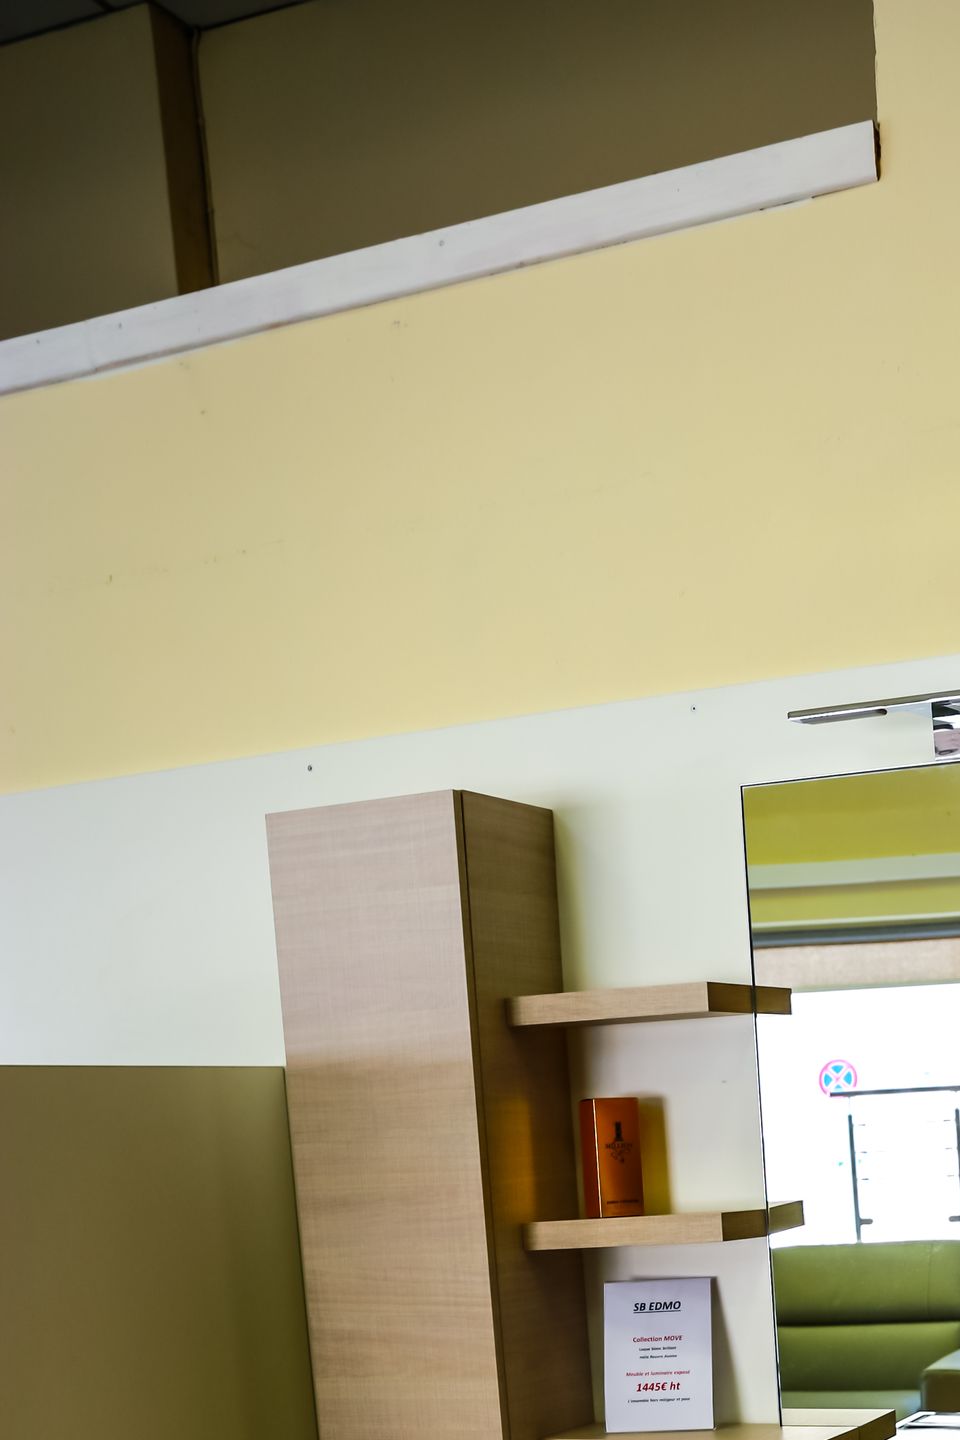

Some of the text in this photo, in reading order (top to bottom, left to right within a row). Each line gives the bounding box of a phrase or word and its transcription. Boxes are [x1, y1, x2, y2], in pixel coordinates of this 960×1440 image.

[633, 1300, 682, 1312] SB EDMO
[632, 1335, 663, 1343] Collection
[636, 1381, 681, 1392] 1445€ ht
